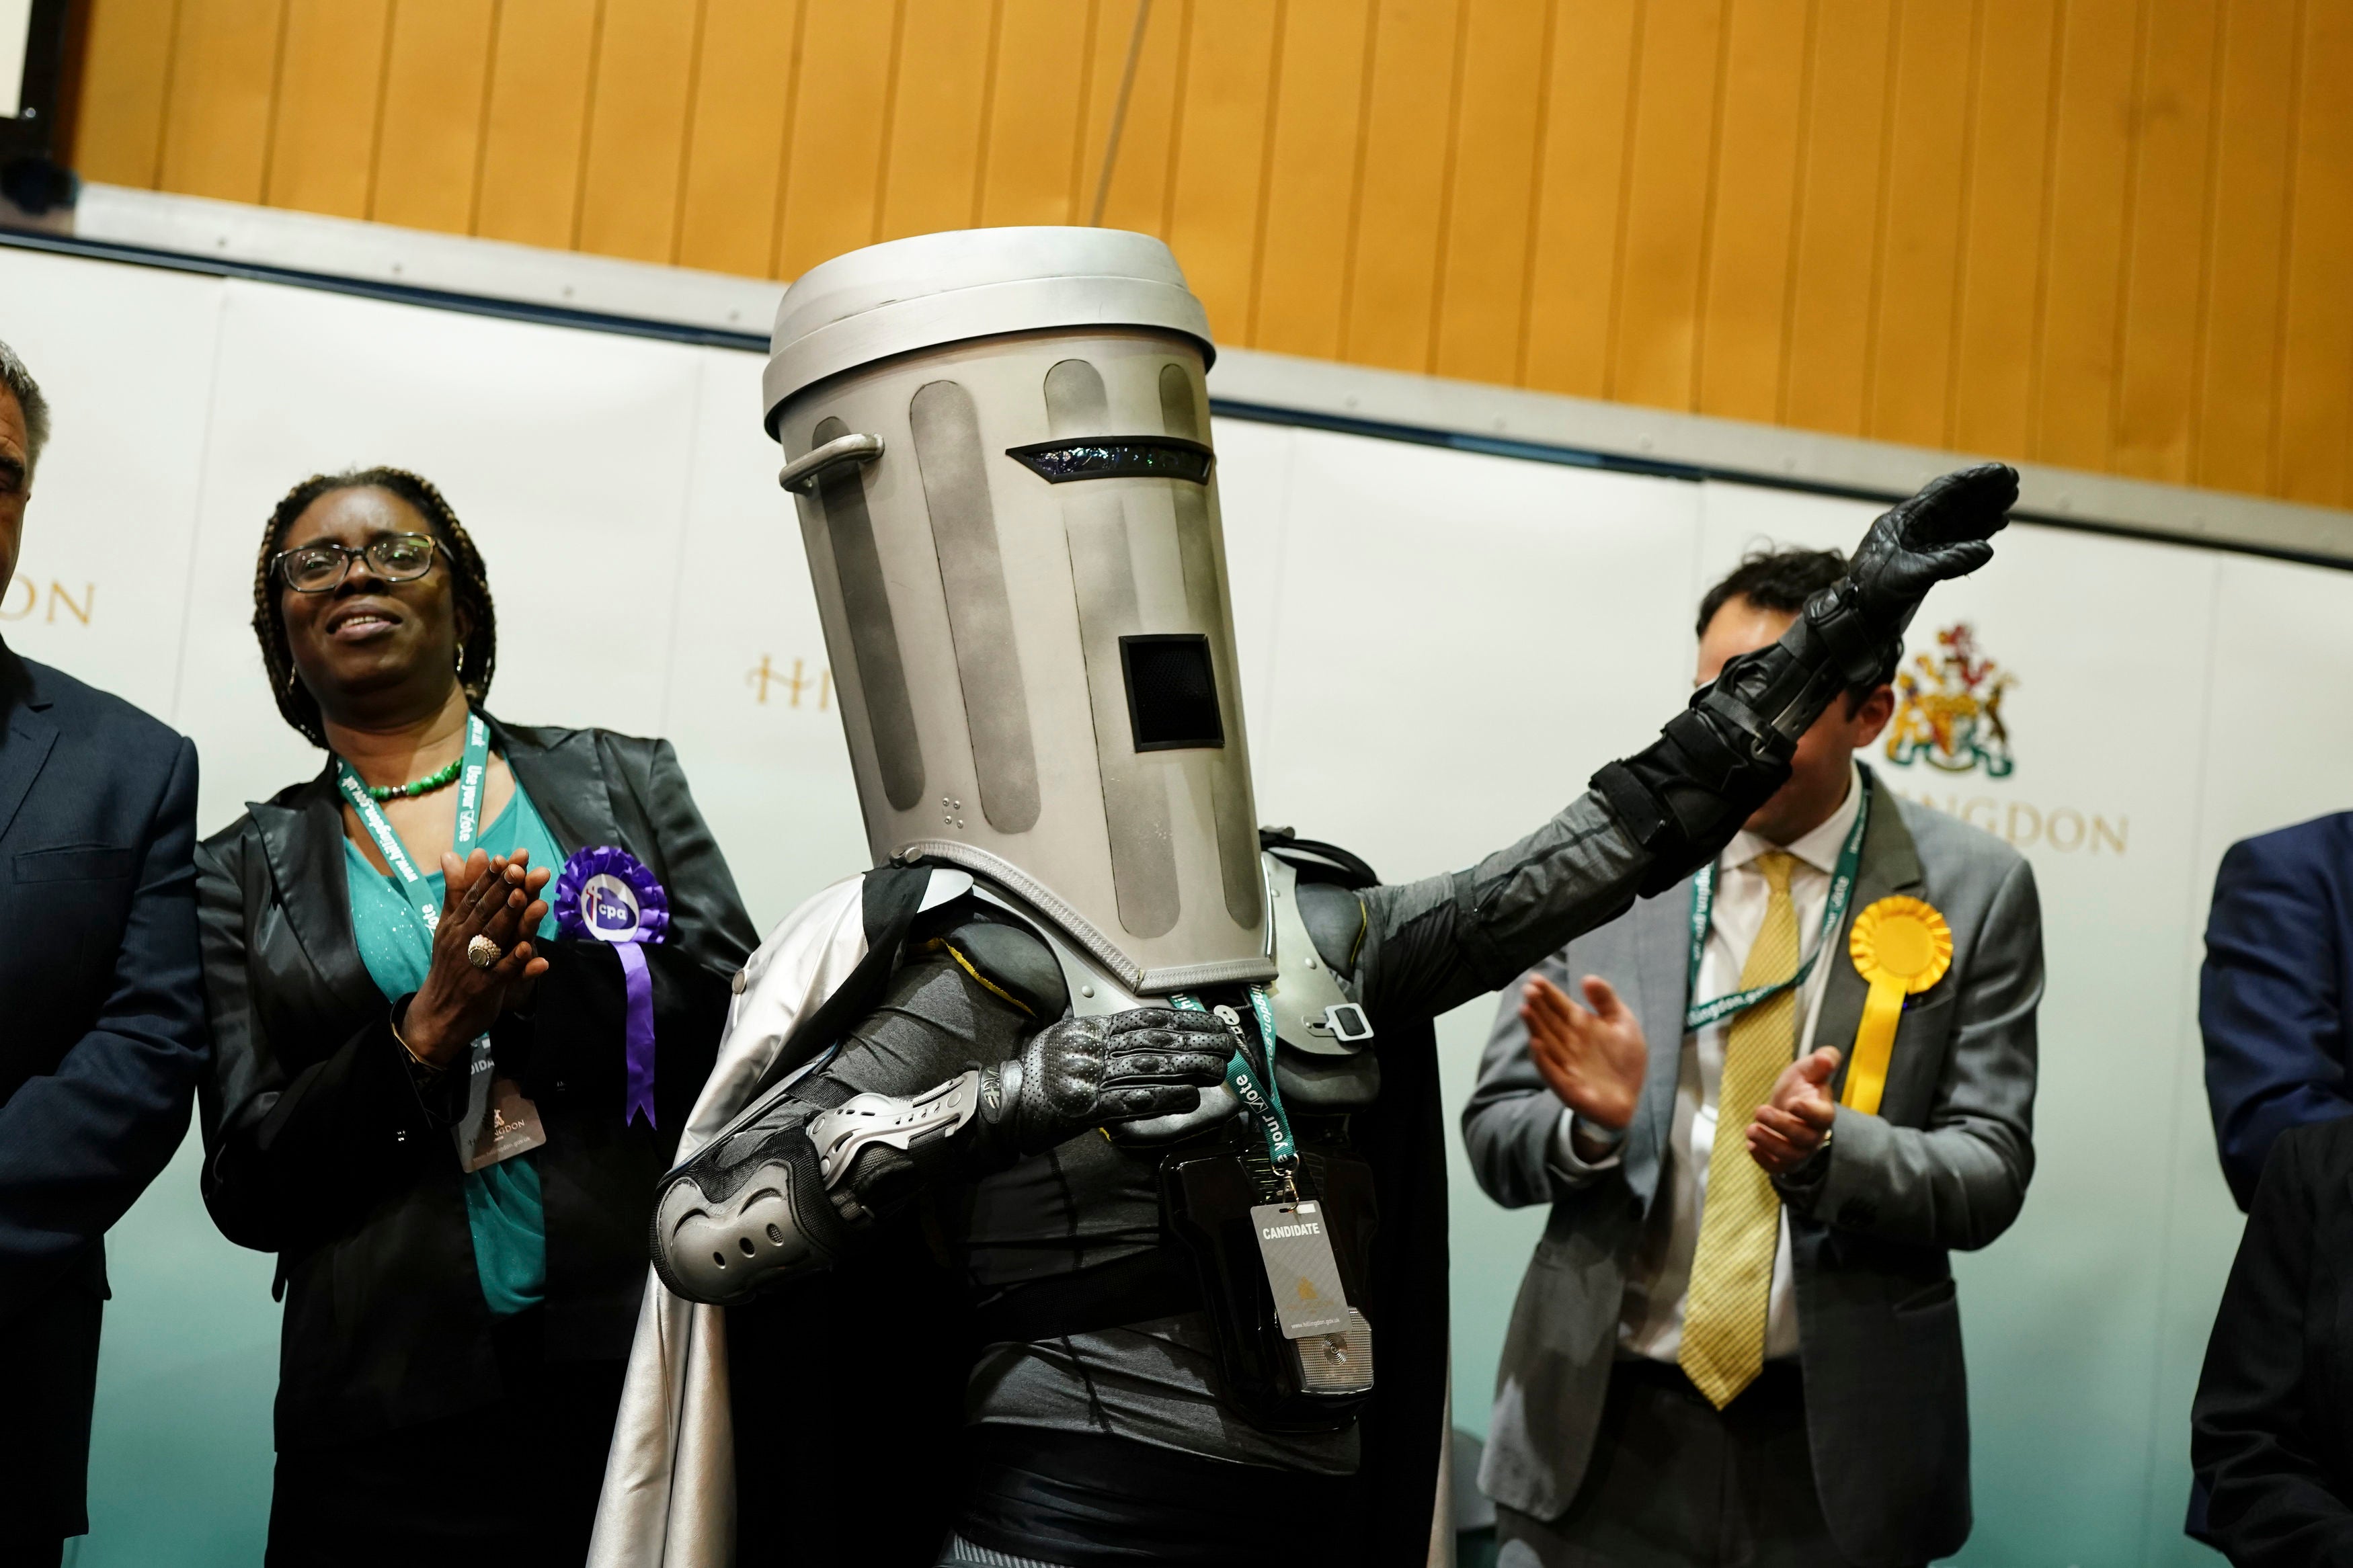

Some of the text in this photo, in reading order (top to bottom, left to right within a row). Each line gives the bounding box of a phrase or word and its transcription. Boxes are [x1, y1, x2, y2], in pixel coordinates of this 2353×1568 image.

[466, 764, 483, 785] Use
[461, 784, 477, 809] your
[598, 903, 627, 921] cpa
[1262, 1115, 1289, 1152] your
[1263, 1222, 1320, 1240] CANDIDATE
